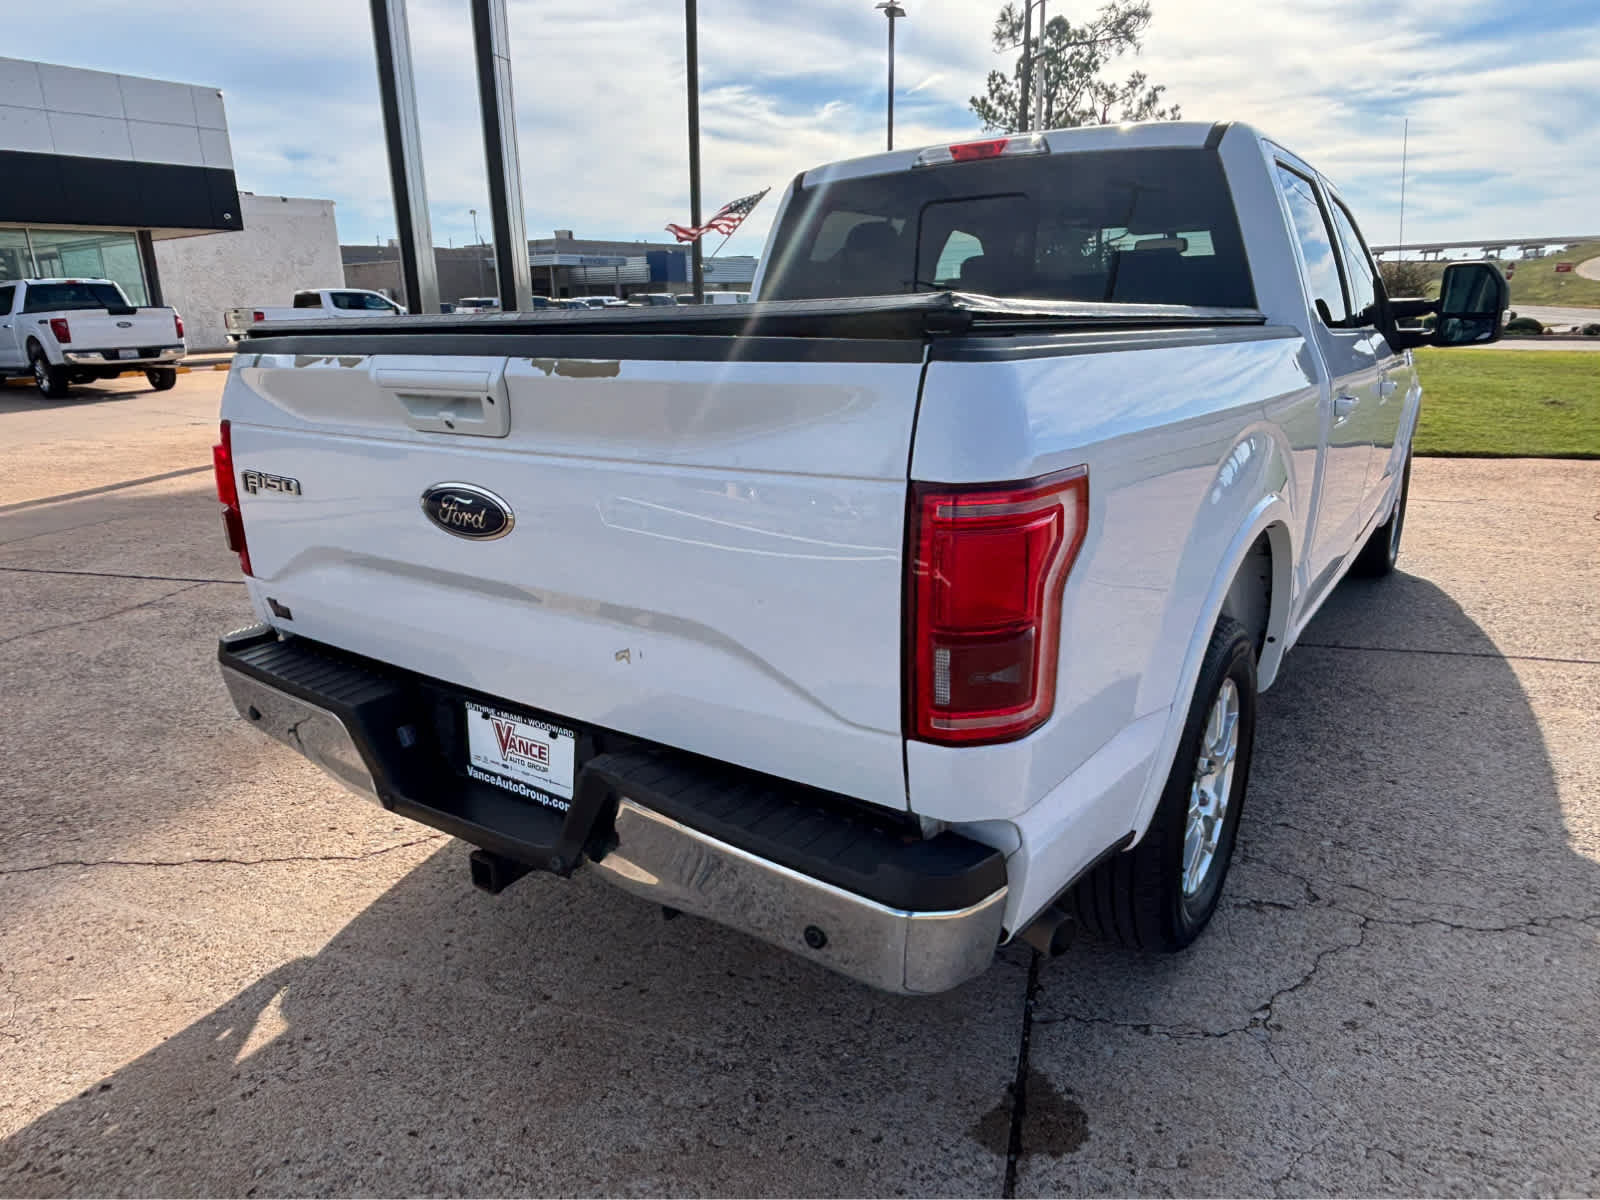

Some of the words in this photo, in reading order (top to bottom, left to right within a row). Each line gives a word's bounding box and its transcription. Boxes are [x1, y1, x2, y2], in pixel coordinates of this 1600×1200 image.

[439, 494, 487, 529] Ford
[465, 701, 496, 714] GUTHRIE
[501, 711, 523, 724] MIAMI
[528, 719, 574, 738] WOODWARD
[509, 756, 525, 766] AUTO
[527, 761, 549, 772] GROUP
